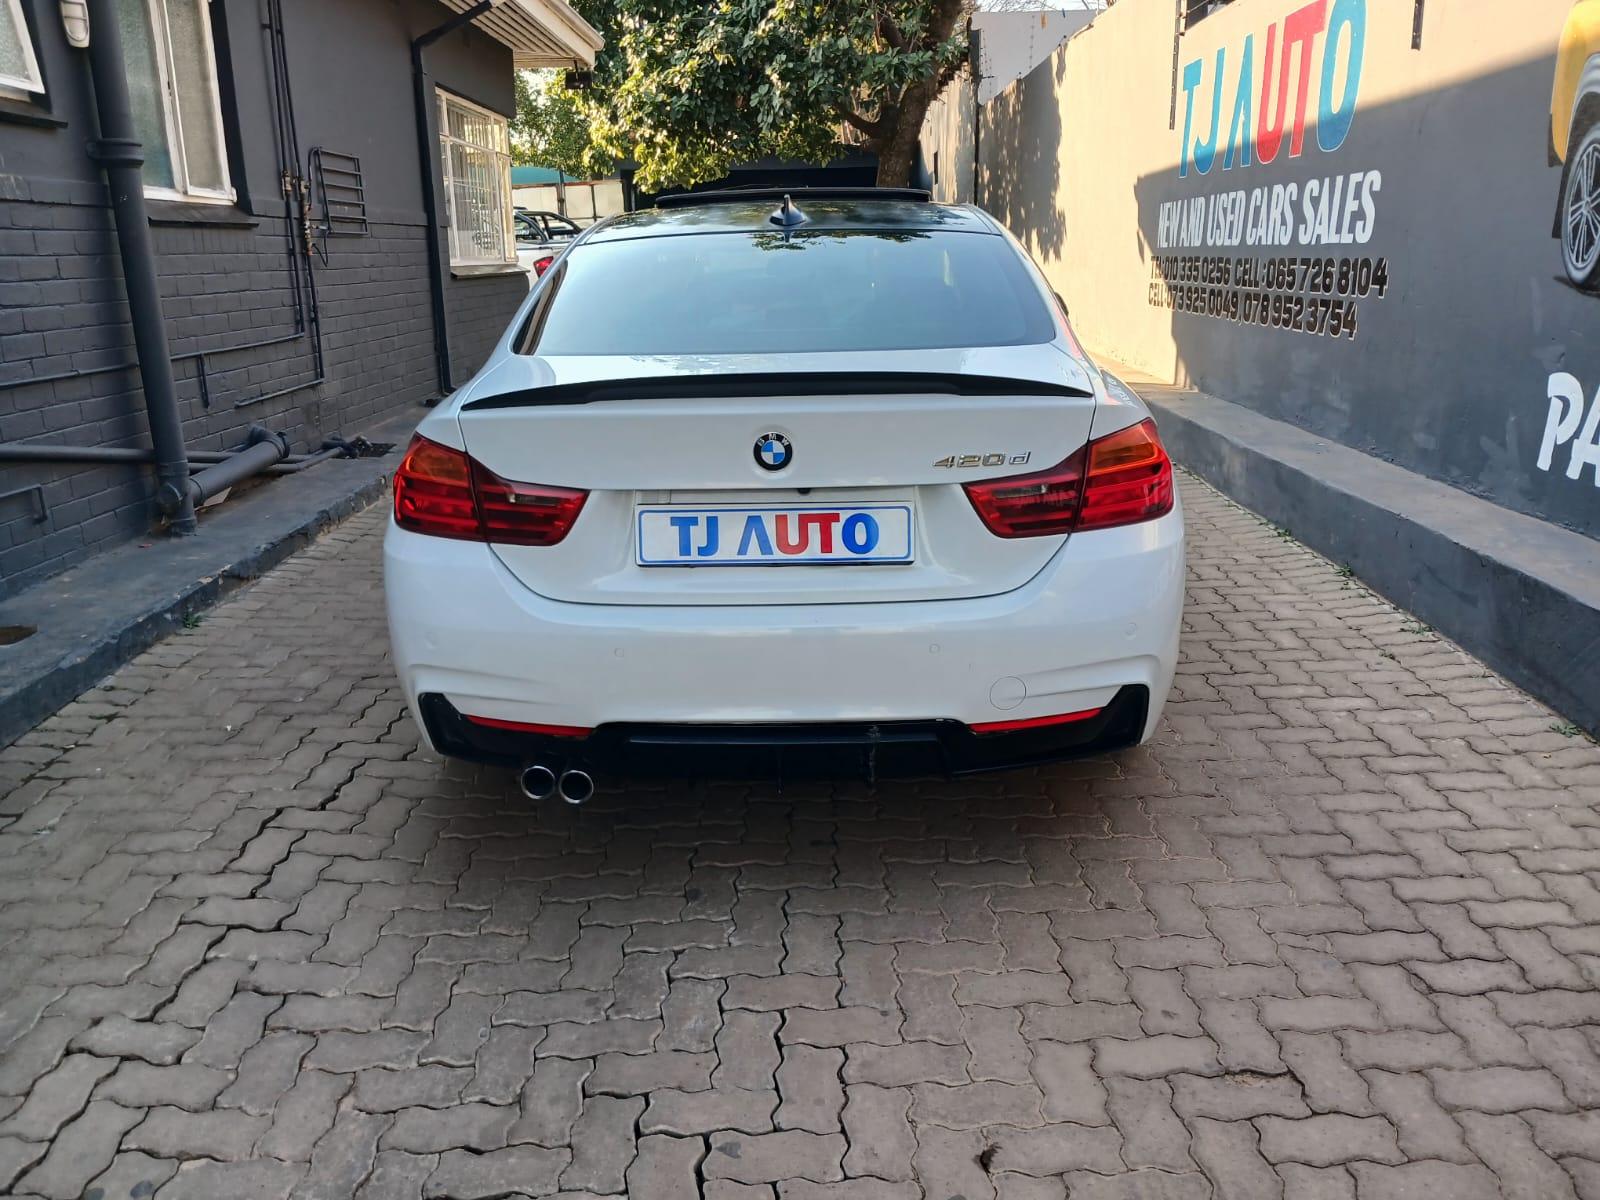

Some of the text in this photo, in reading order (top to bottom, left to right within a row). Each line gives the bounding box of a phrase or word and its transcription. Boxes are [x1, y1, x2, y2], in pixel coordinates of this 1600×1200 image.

[1178, 0, 1368, 179] TJ AUTO
[1157, 170, 1382, 249] NEW AND USED CARS SALES
[1179, 255, 1201, 284] 335
[1200, 256, 1232, 287] 0256
[1299, 258, 1336, 296] 726
[1336, 258, 1390, 299] 8104
[1185, 285, 1208, 316] 925
[1242, 292, 1271, 327] 078
[1271, 294, 1306, 332] 952
[1305, 298, 1358, 341] 3754
[670, 512, 880, 557] TJ AUTO
